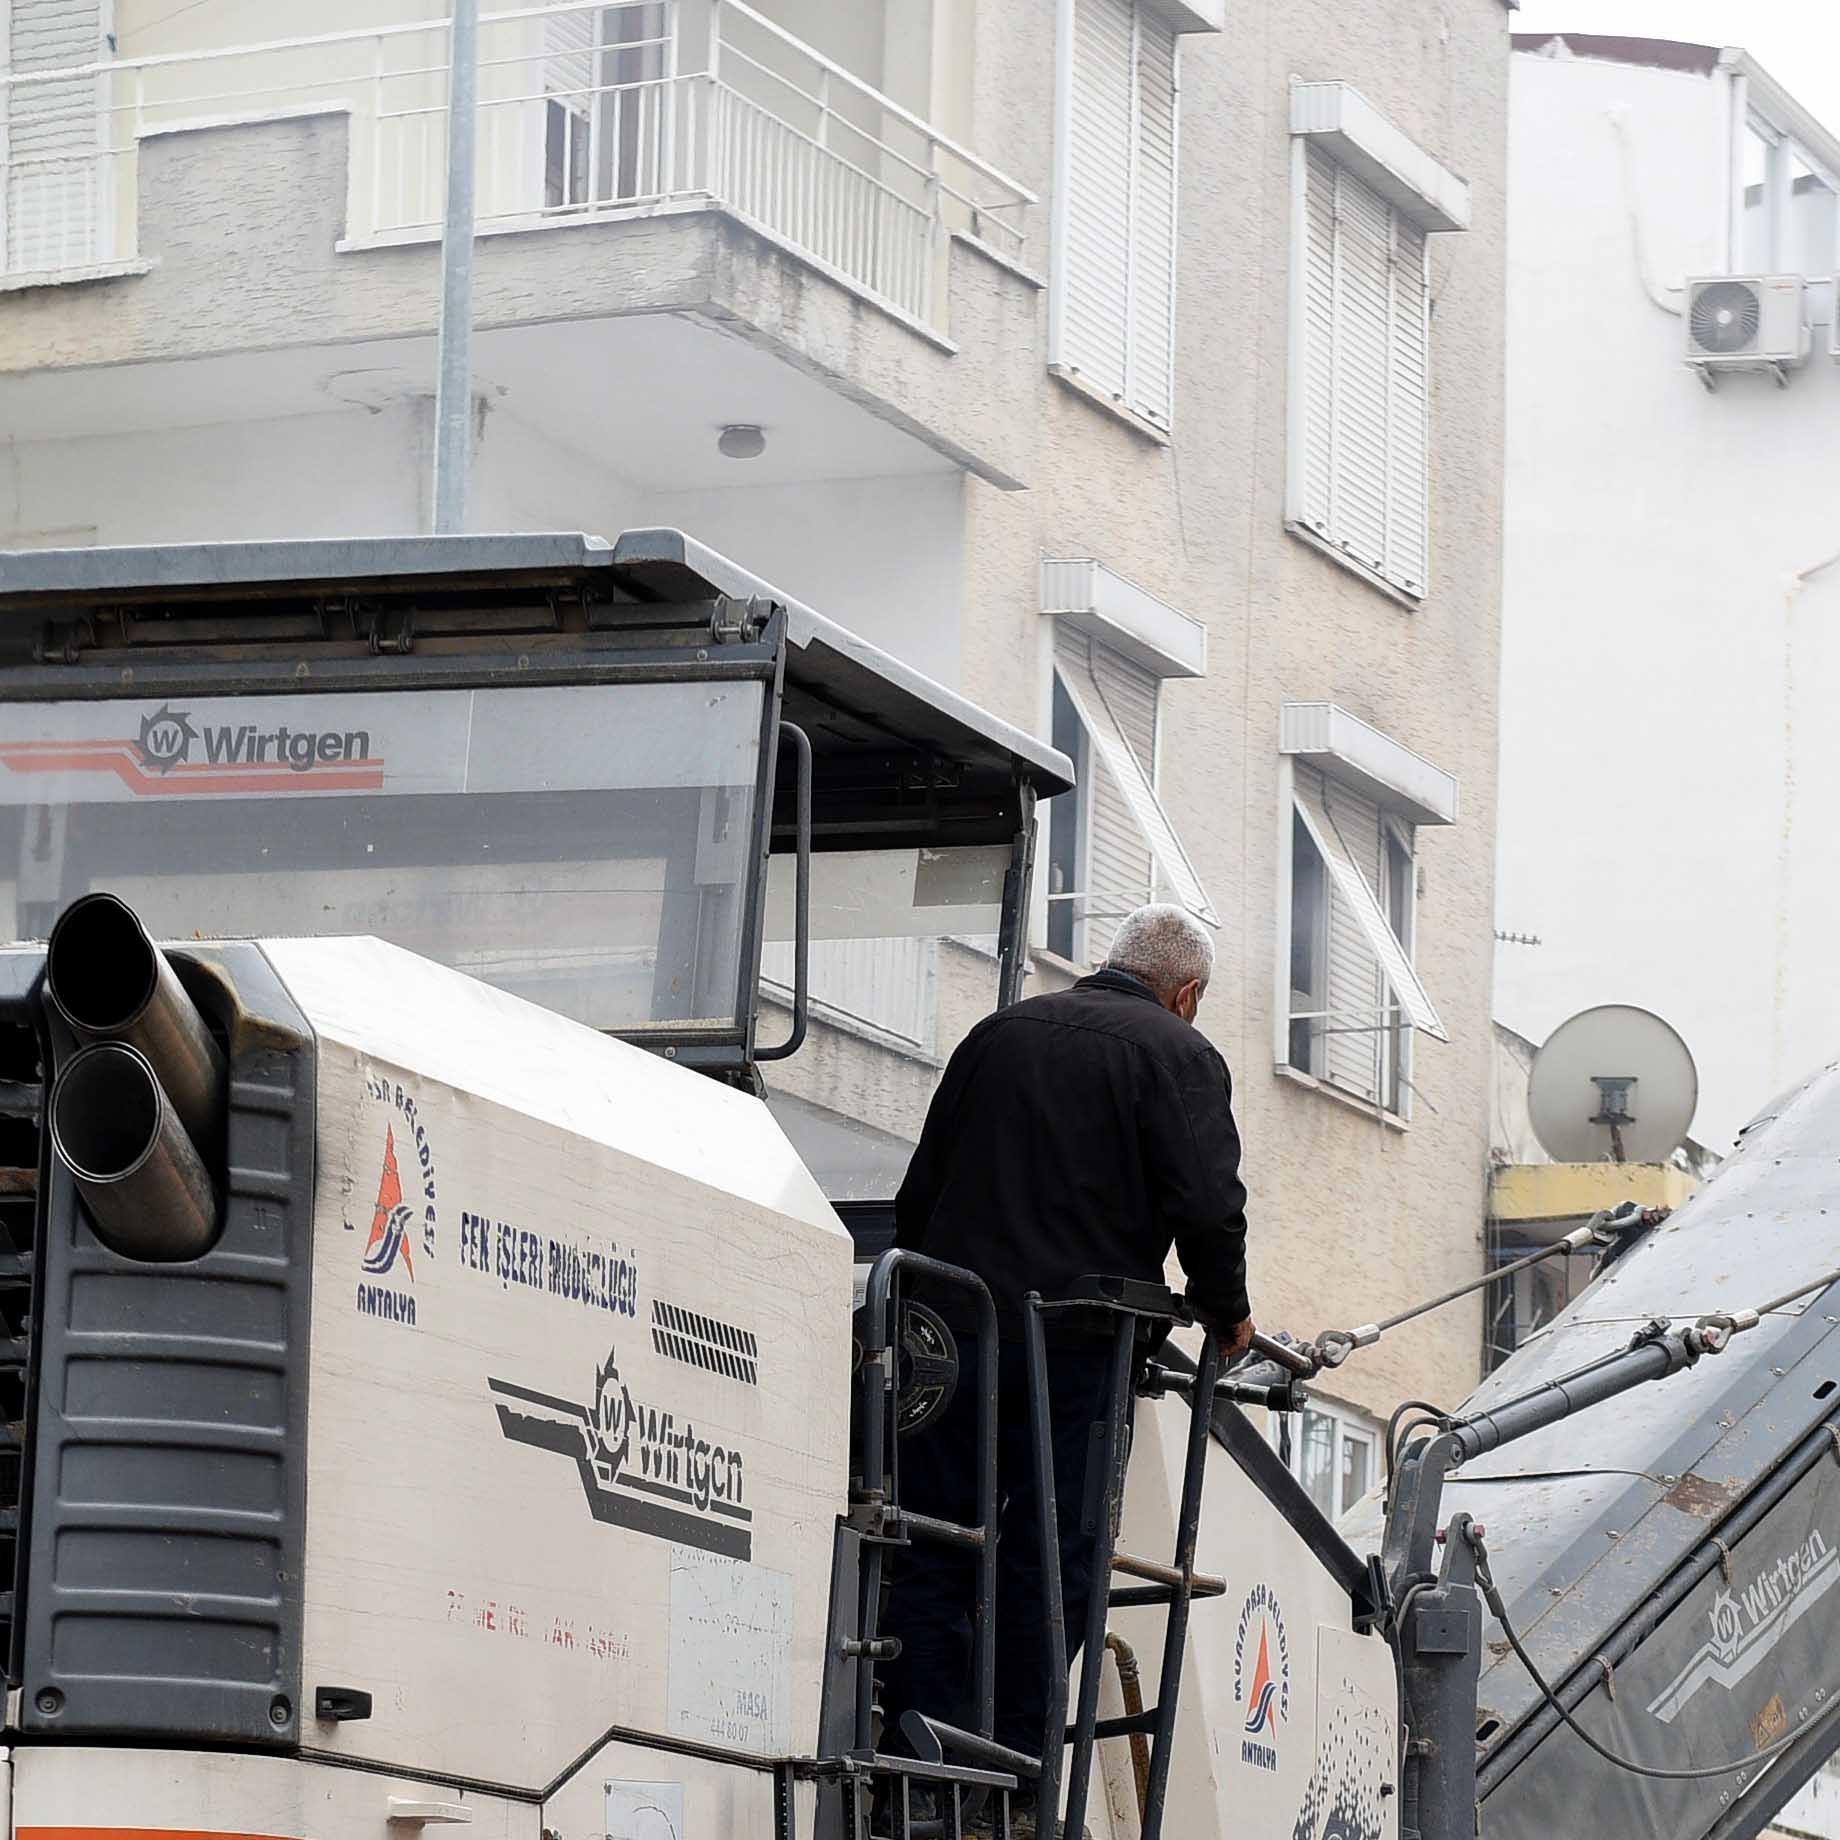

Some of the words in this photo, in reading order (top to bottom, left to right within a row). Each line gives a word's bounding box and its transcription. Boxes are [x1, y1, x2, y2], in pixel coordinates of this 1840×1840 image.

[203, 725, 369, 771] Wirtgen
[460, 1211, 490, 1272] FEN
[356, 1282, 416, 1325] ANTALYA
[1740, 1529, 1827, 1625] Wirtgen
[1241, 1740, 1277, 1771] ANTALYA
